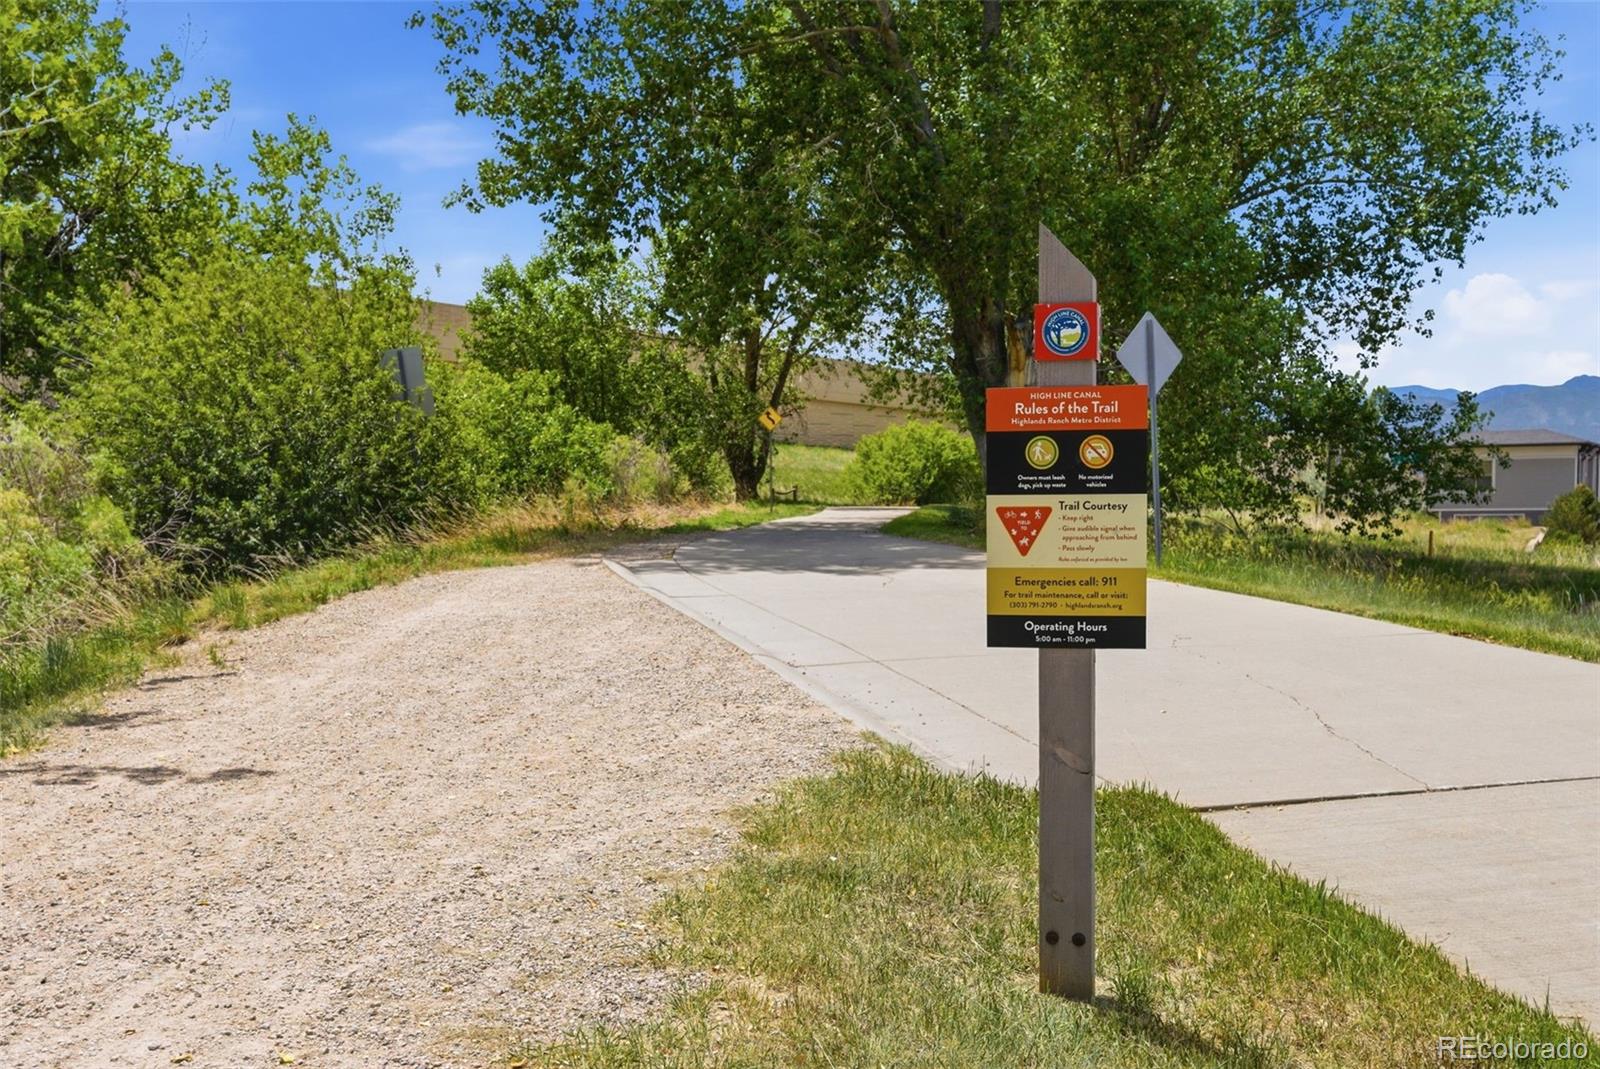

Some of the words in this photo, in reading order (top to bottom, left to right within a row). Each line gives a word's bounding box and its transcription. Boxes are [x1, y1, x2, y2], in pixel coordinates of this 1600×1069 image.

[1015, 403, 1048, 414] Rules
[1052, 402, 1064, 414] of
[1068, 402, 1088, 414] the
[1092, 401, 1118, 413] Trail
[1011, 418, 1046, 426] Highlands
[1059, 501, 1079, 510] Trail
[1082, 501, 1128, 513] Courtesy
[1015, 576, 1076, 589] Emergencies
[1079, 577, 1098, 586] call:
[1101, 577, 1117, 586] 911
[1024, 620, 1074, 634] Operating
[1077, 622, 1107, 631] Hours
